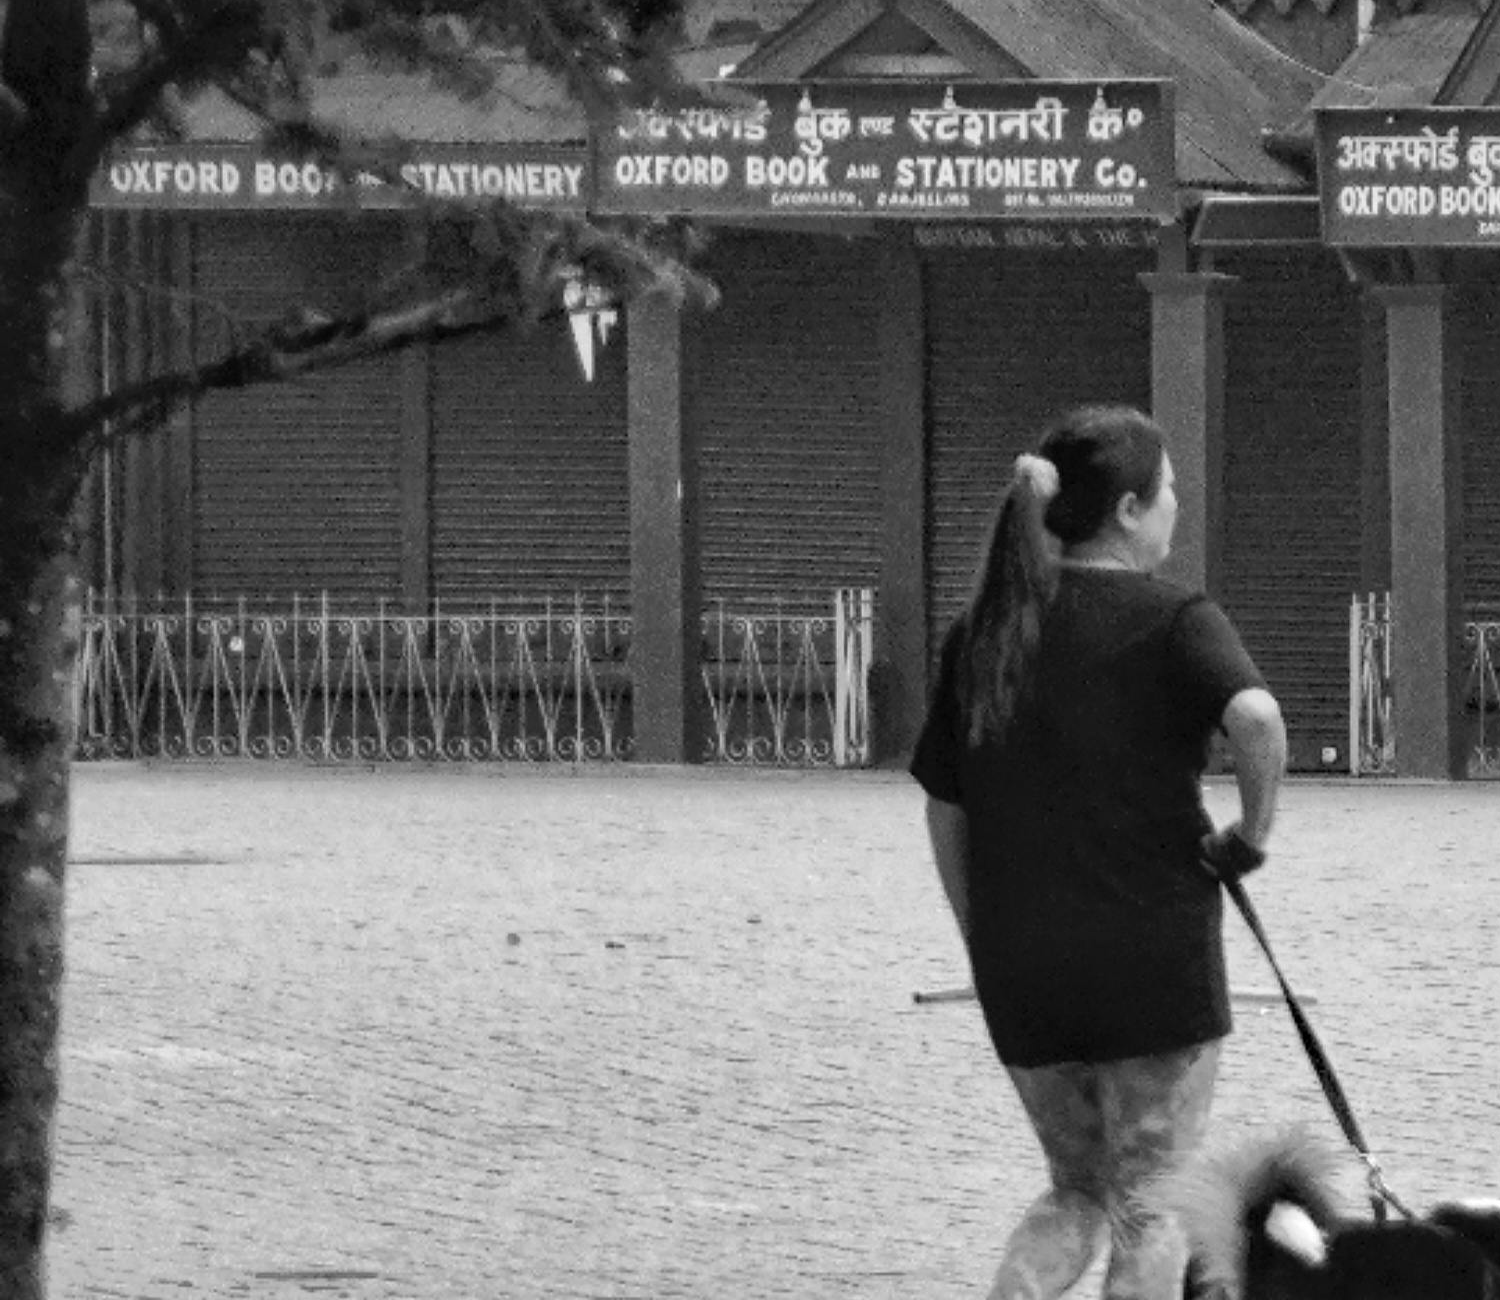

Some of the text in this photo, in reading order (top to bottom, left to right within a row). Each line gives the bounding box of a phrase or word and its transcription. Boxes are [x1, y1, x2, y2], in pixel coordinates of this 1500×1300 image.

[111, 160, 239, 194] OXFORD
[401, 163, 583, 197] STATIONERY
[616, 156, 1148, 188] OXFORD BOOK AND STATIONERY Co.
[1340, 186, 1436, 216] OXFORD
